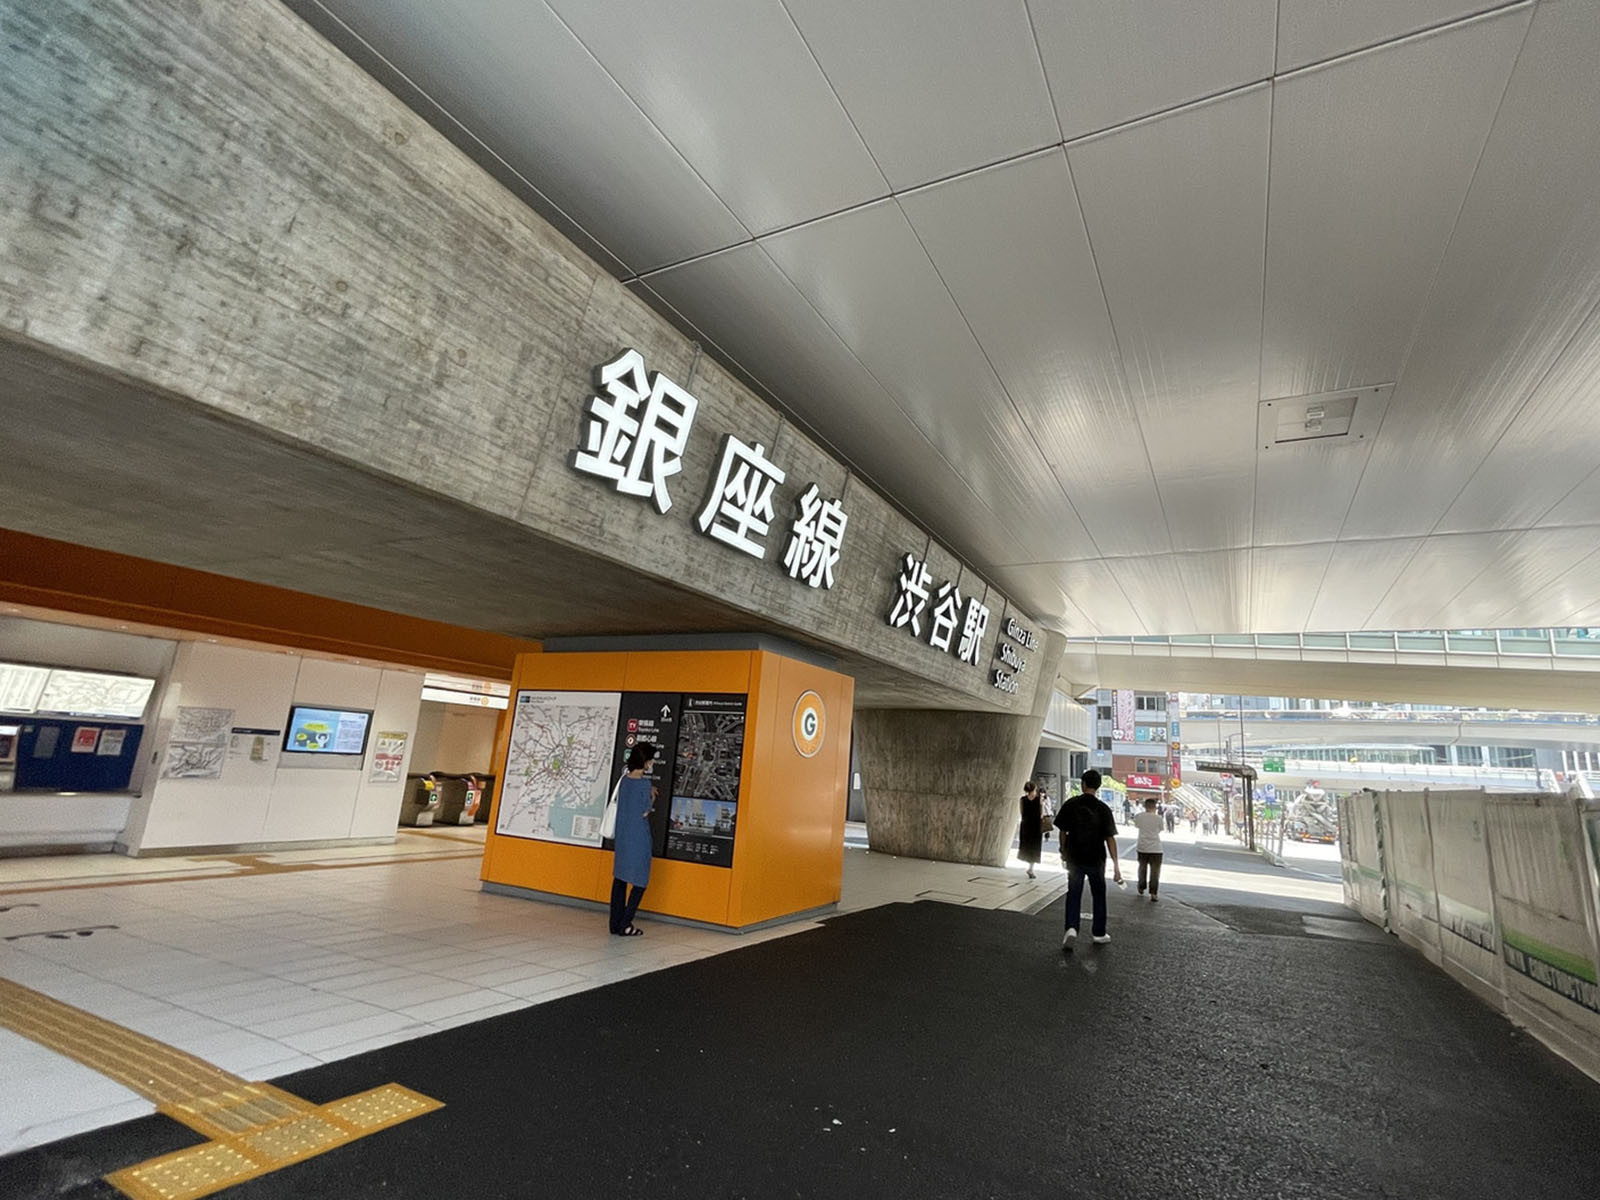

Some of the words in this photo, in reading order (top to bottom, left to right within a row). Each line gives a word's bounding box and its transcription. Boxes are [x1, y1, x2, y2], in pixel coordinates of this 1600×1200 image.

[572, 348, 849, 590] 銀座線
[888, 552, 990, 666] 渋谷駅
[1007, 617, 1026, 645] Ginza
[1000, 643, 1027, 674] Shibuya
[994, 669, 1019, 695] Station
[804, 712, 816, 736] G
